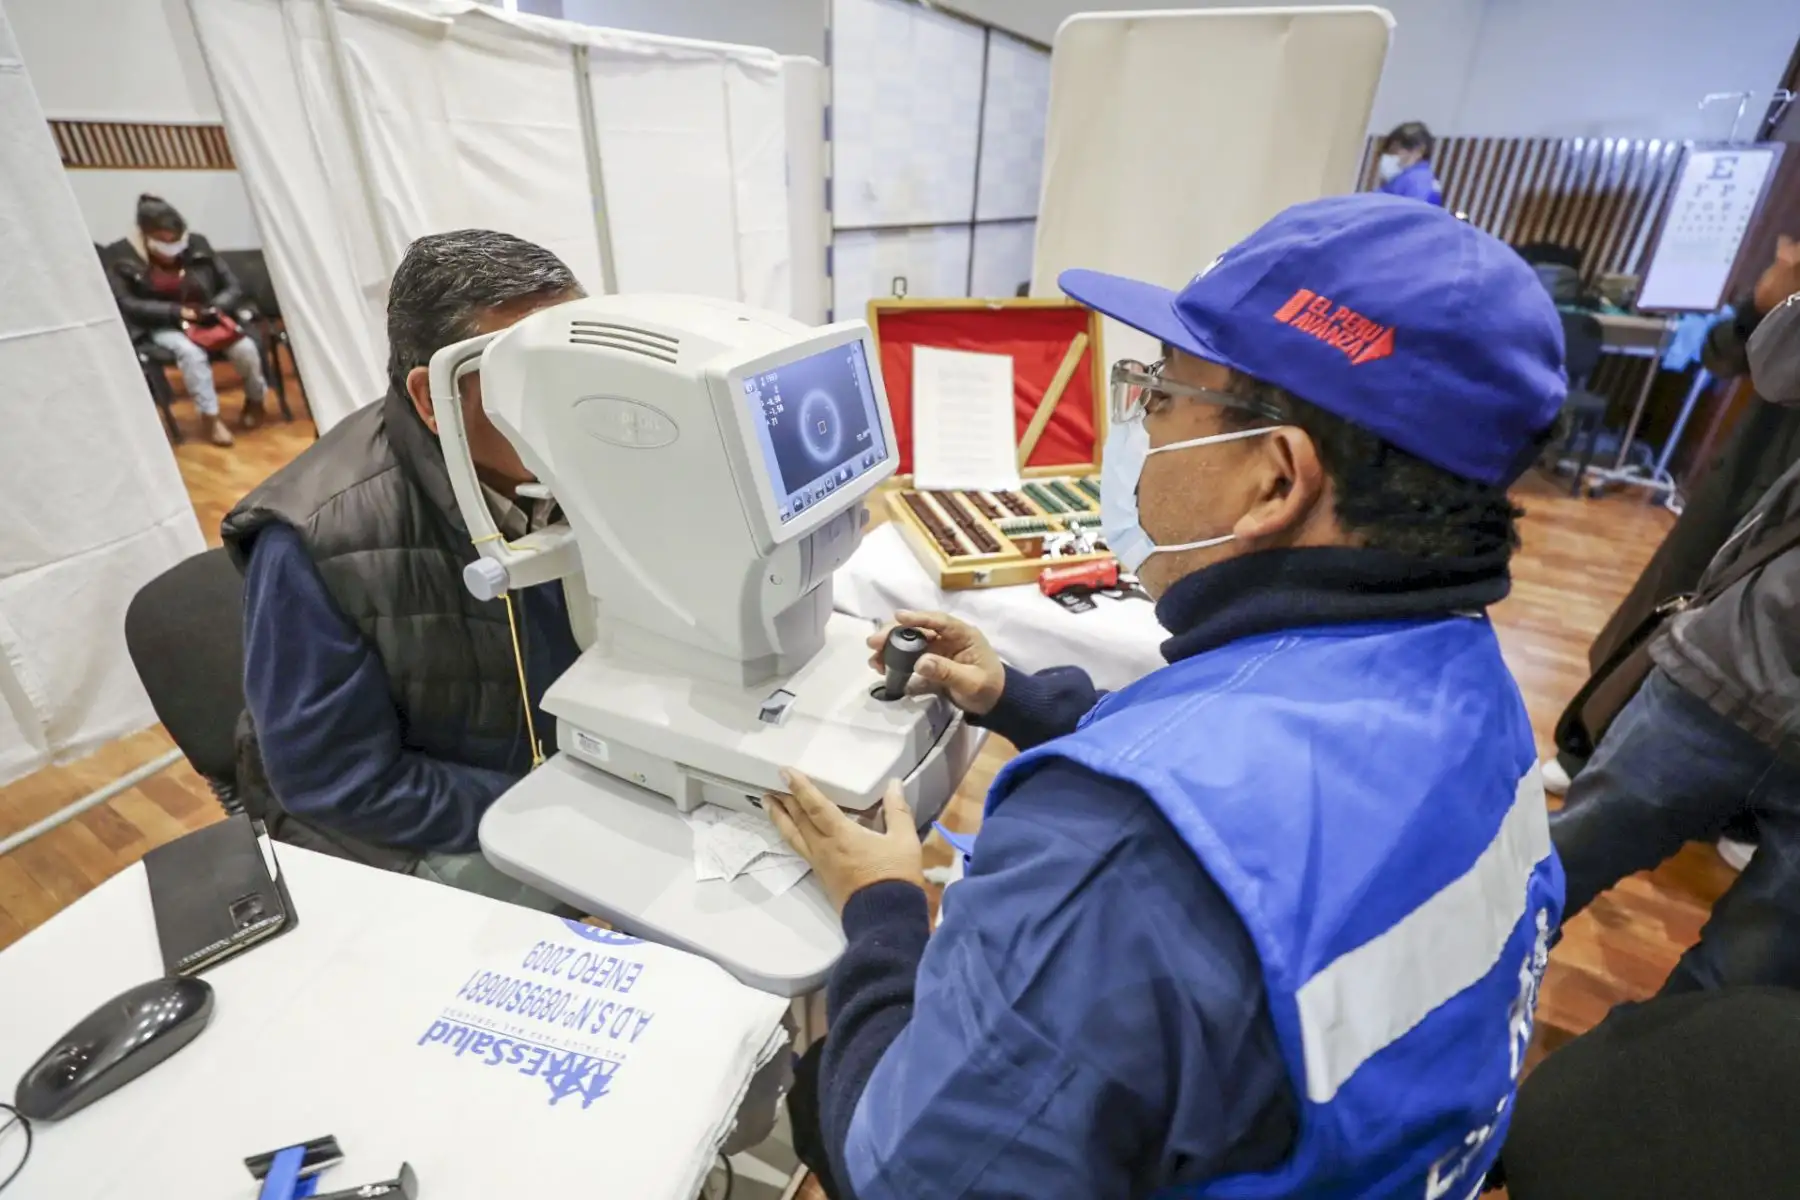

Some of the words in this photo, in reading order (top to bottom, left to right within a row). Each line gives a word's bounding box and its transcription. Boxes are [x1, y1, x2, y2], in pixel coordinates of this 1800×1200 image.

[1706, 155, 1739, 180] E
[1308, 296, 1332, 319] EL
[1289, 311, 1364, 358] AVANZA
[522, 941, 576, 976] 2009
[567, 951, 644, 993] ENERO
[417, 1020, 552, 1076] EsSalud
